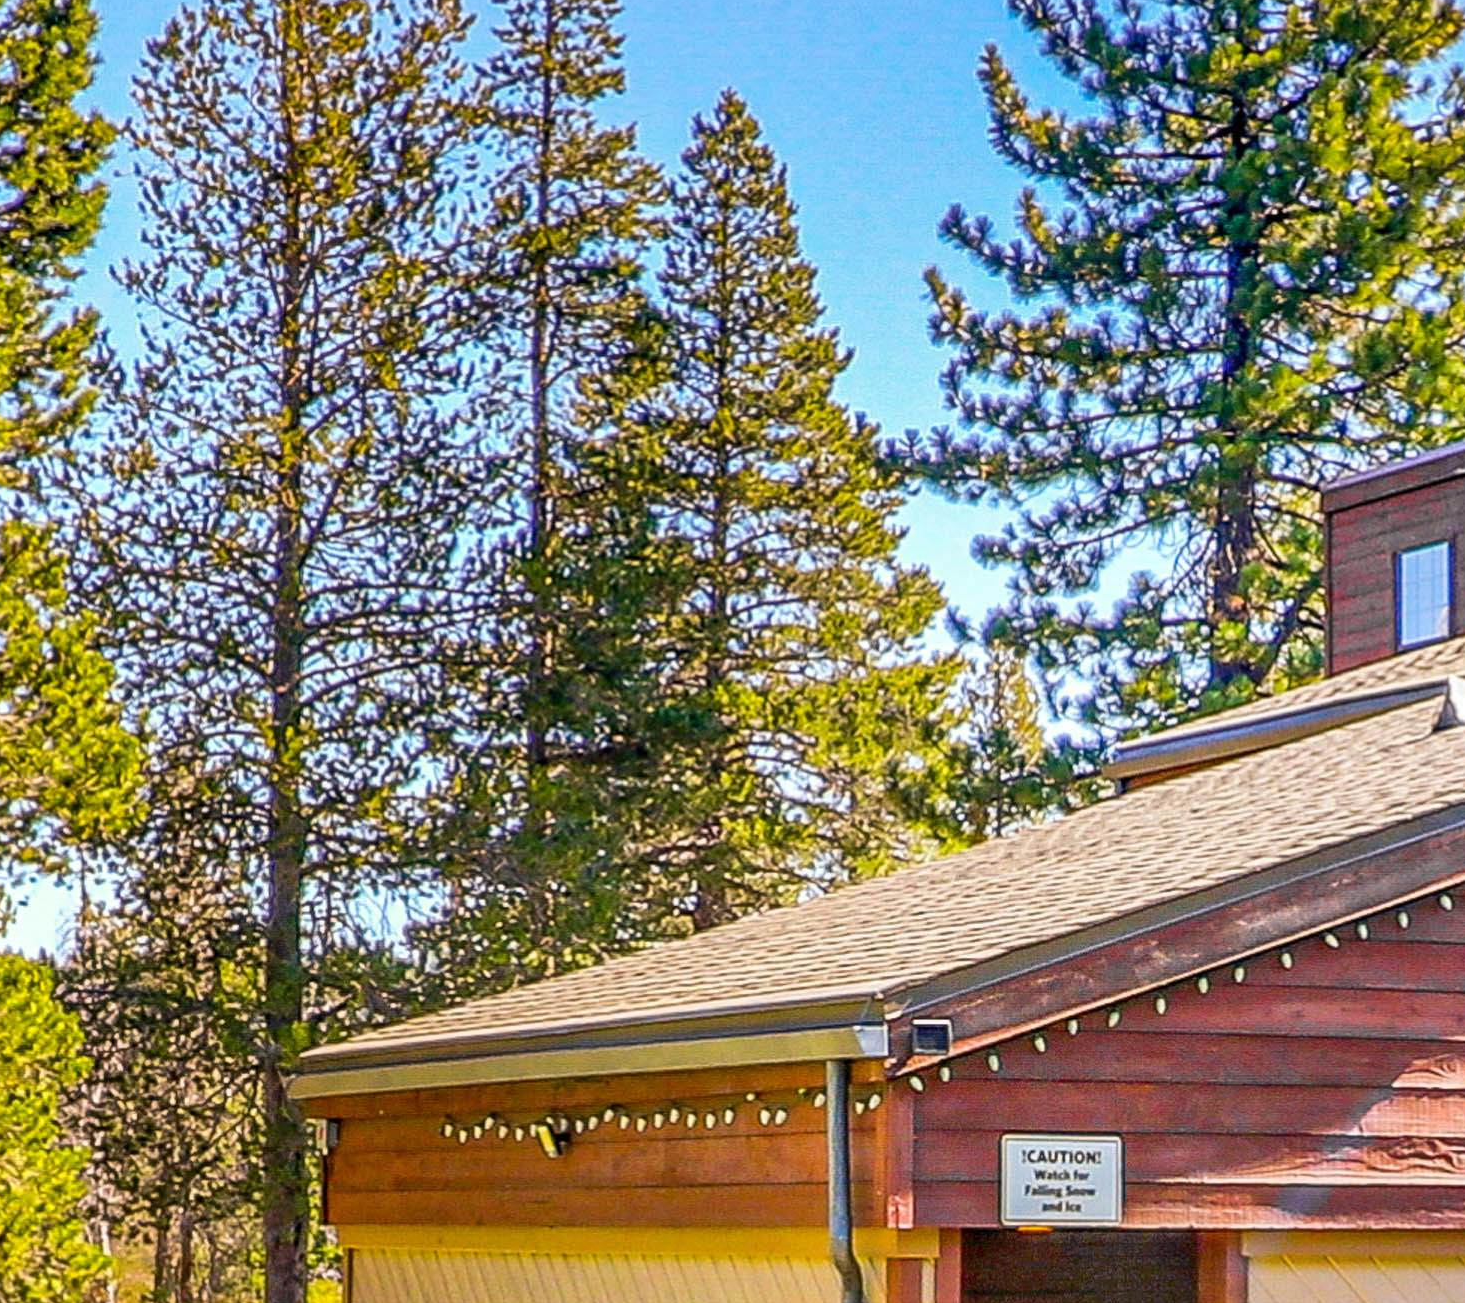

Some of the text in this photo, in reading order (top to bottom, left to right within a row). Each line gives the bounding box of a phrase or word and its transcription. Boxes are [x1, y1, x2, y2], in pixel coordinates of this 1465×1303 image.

[1034, 1169, 1090, 1181] Watch for
[1025, 1185, 1096, 1198] Falling Snow
[1042, 1201, 1062, 1212] and
